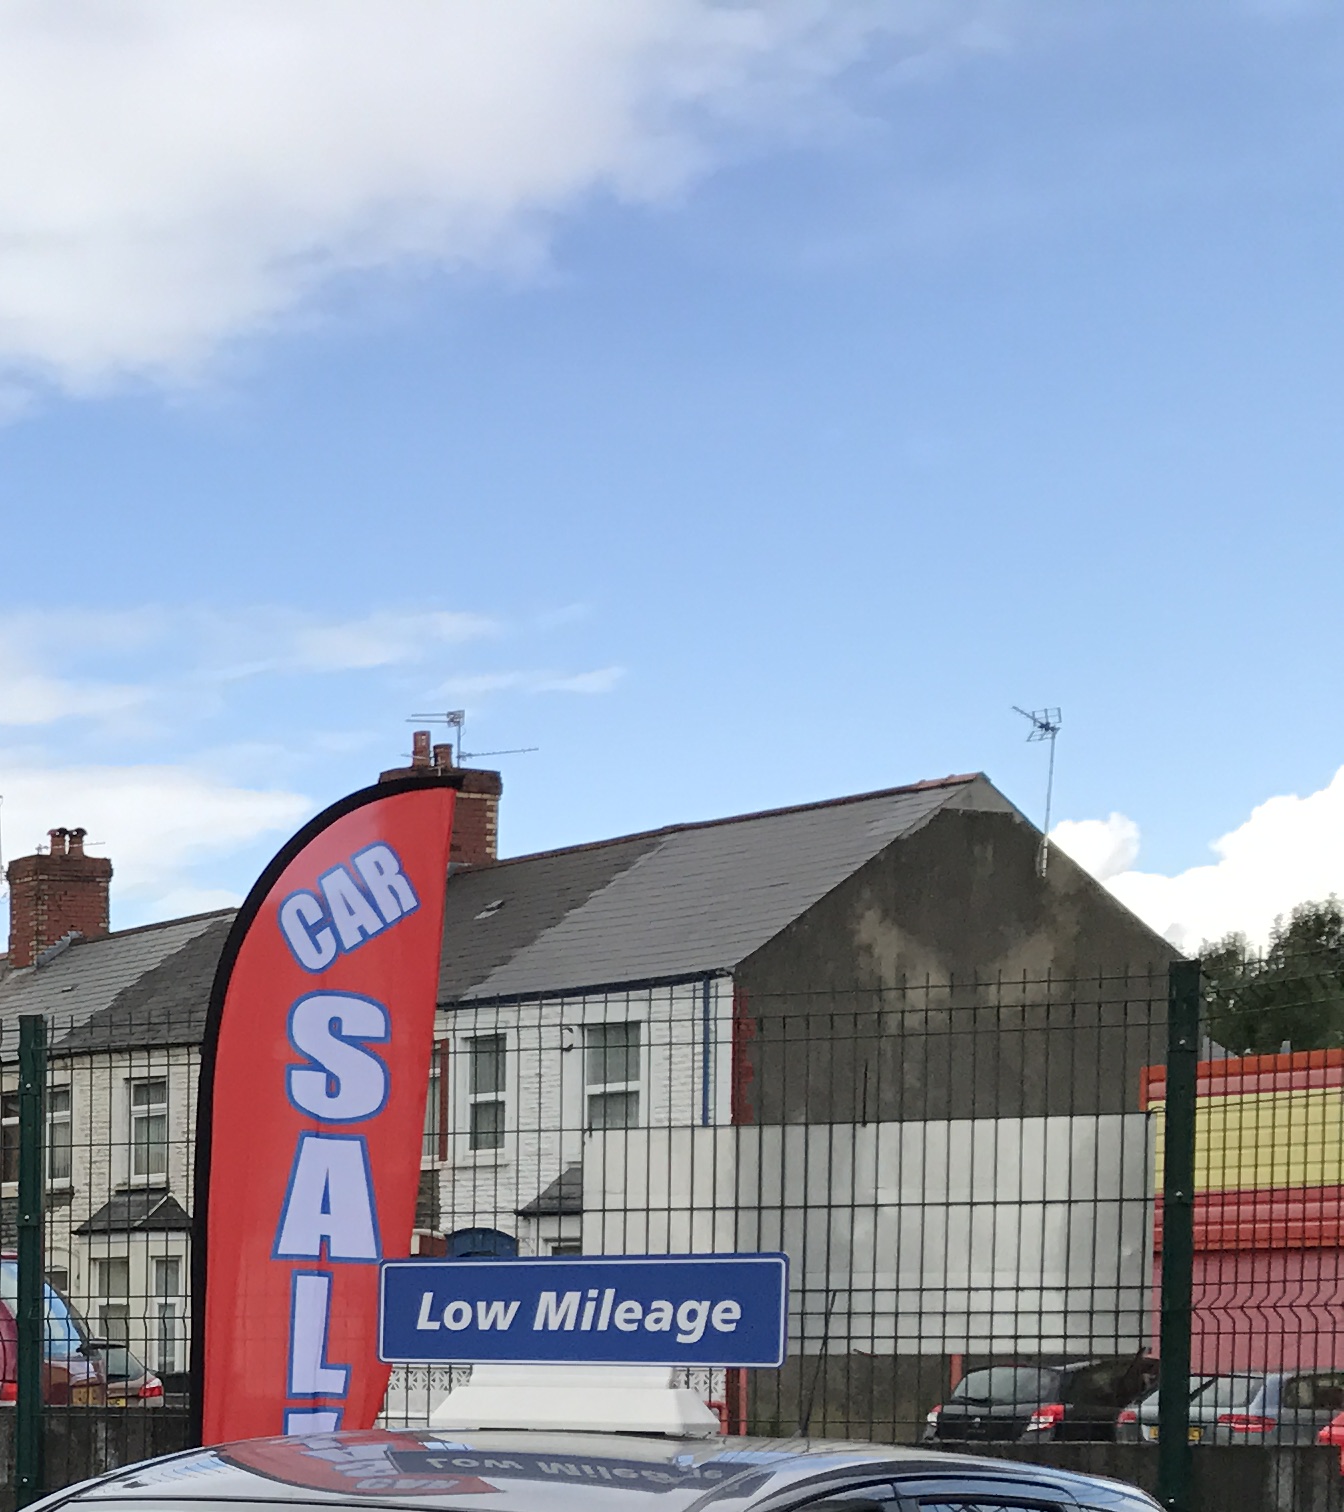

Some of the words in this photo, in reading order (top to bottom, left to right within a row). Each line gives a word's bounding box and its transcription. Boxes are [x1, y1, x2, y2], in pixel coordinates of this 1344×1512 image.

[278, 841, 419, 974] CAR
[272, 989, 391, 1434] SAL
[417, 1292, 518, 1331] Low
[532, 1289, 742, 1343] Mileage
